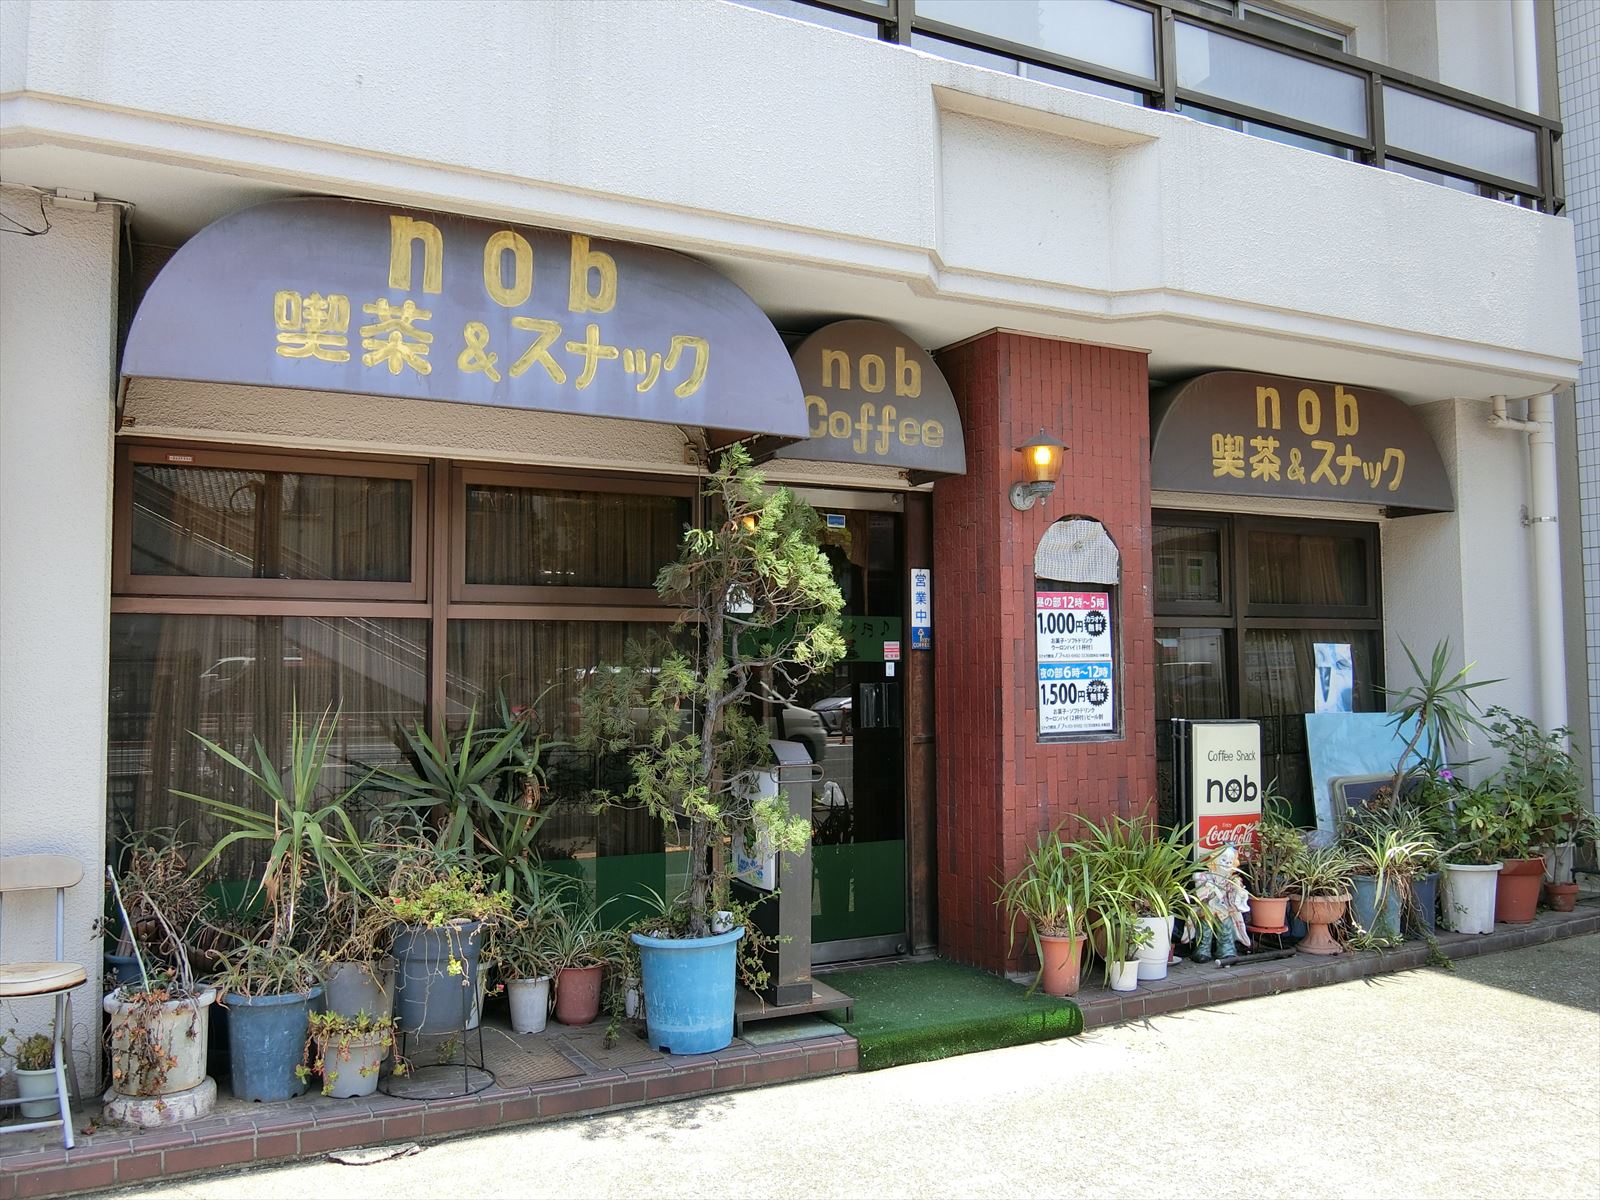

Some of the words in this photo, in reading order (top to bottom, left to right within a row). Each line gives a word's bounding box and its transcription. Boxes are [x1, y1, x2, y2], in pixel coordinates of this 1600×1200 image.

[388, 214, 618, 314] nob
[821, 346, 922, 399] nob
[803, 394, 944, 456] Coffee
[1256, 385, 1360, 436] nob
[915, 573, 927, 624] 営業中
[1037, 612, 1084, 634] 1,000円
[1040, 683, 1086, 706] 1,500円
[1207, 750, 1234, 762] Coffee
[1236, 750, 1256, 761] Snack
[1206, 774, 1258, 803] nob
